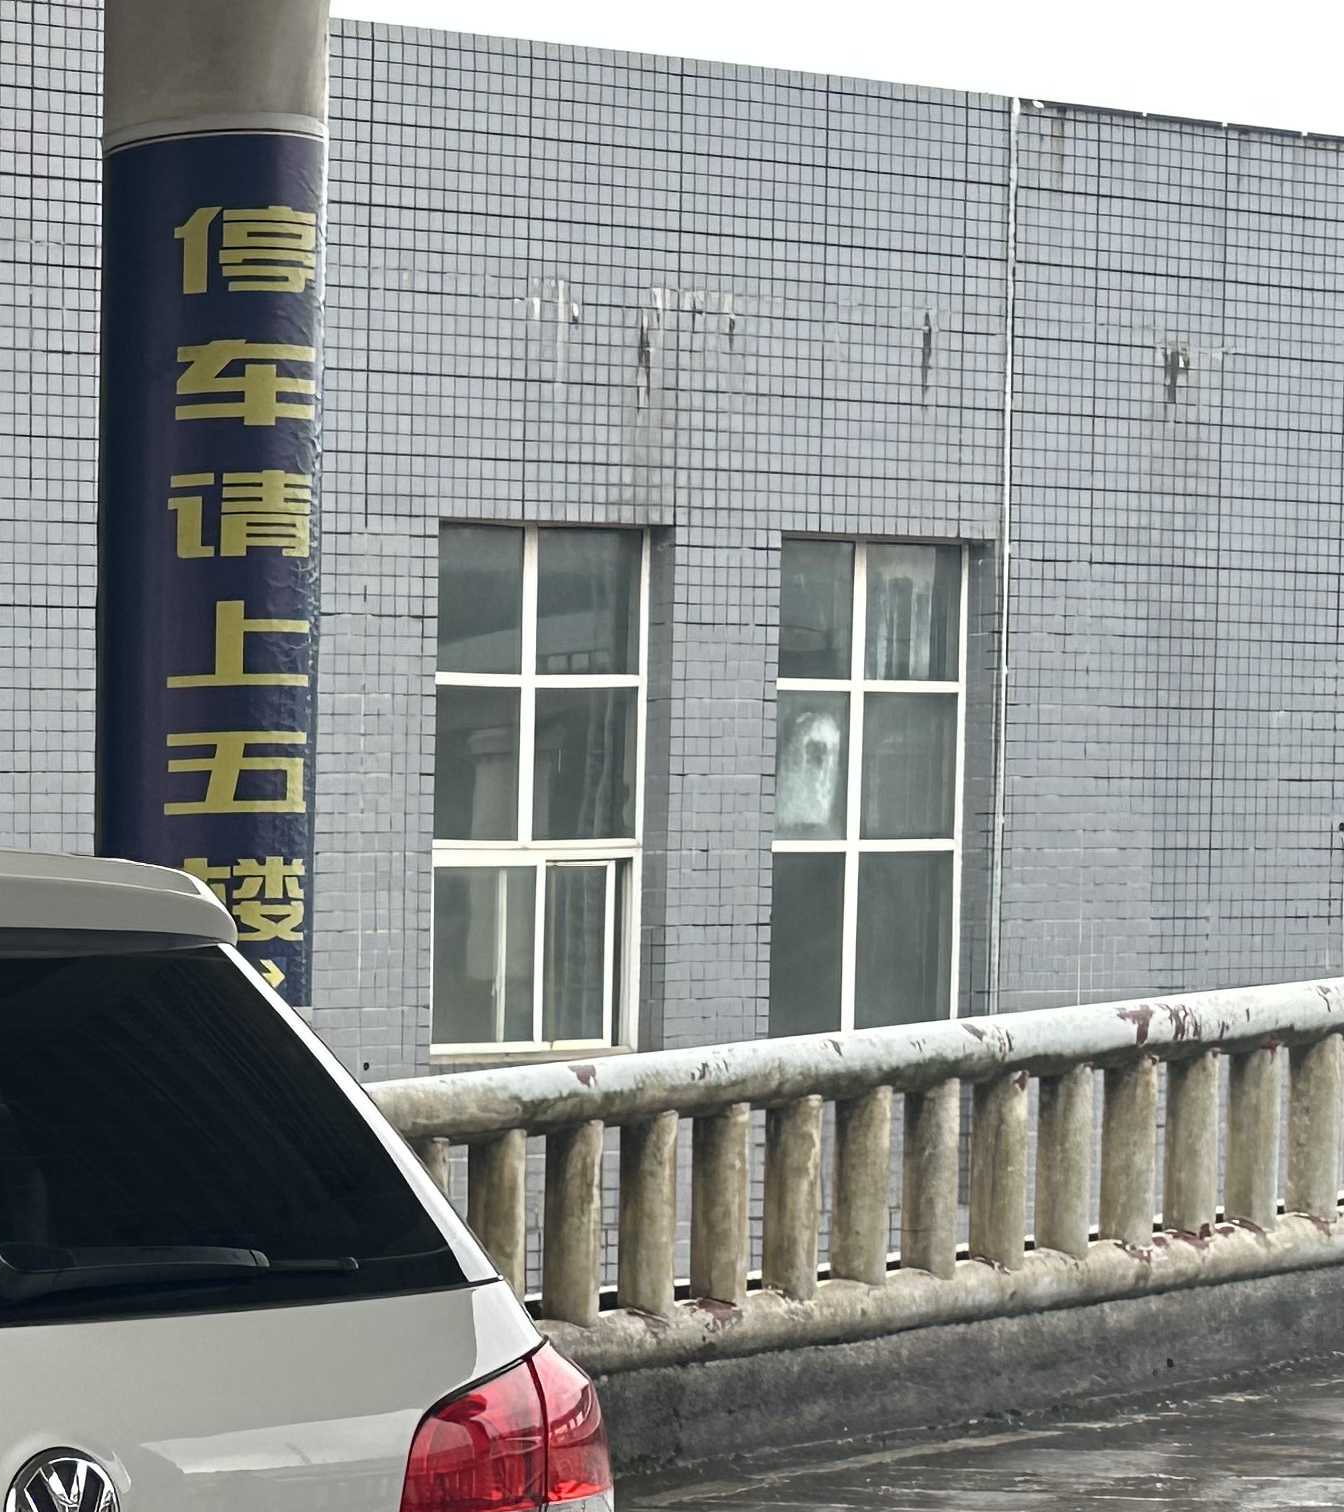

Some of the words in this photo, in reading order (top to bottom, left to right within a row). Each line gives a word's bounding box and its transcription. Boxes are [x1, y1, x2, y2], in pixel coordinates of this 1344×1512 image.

[164, 205, 315, 942] 停车请上五楼
